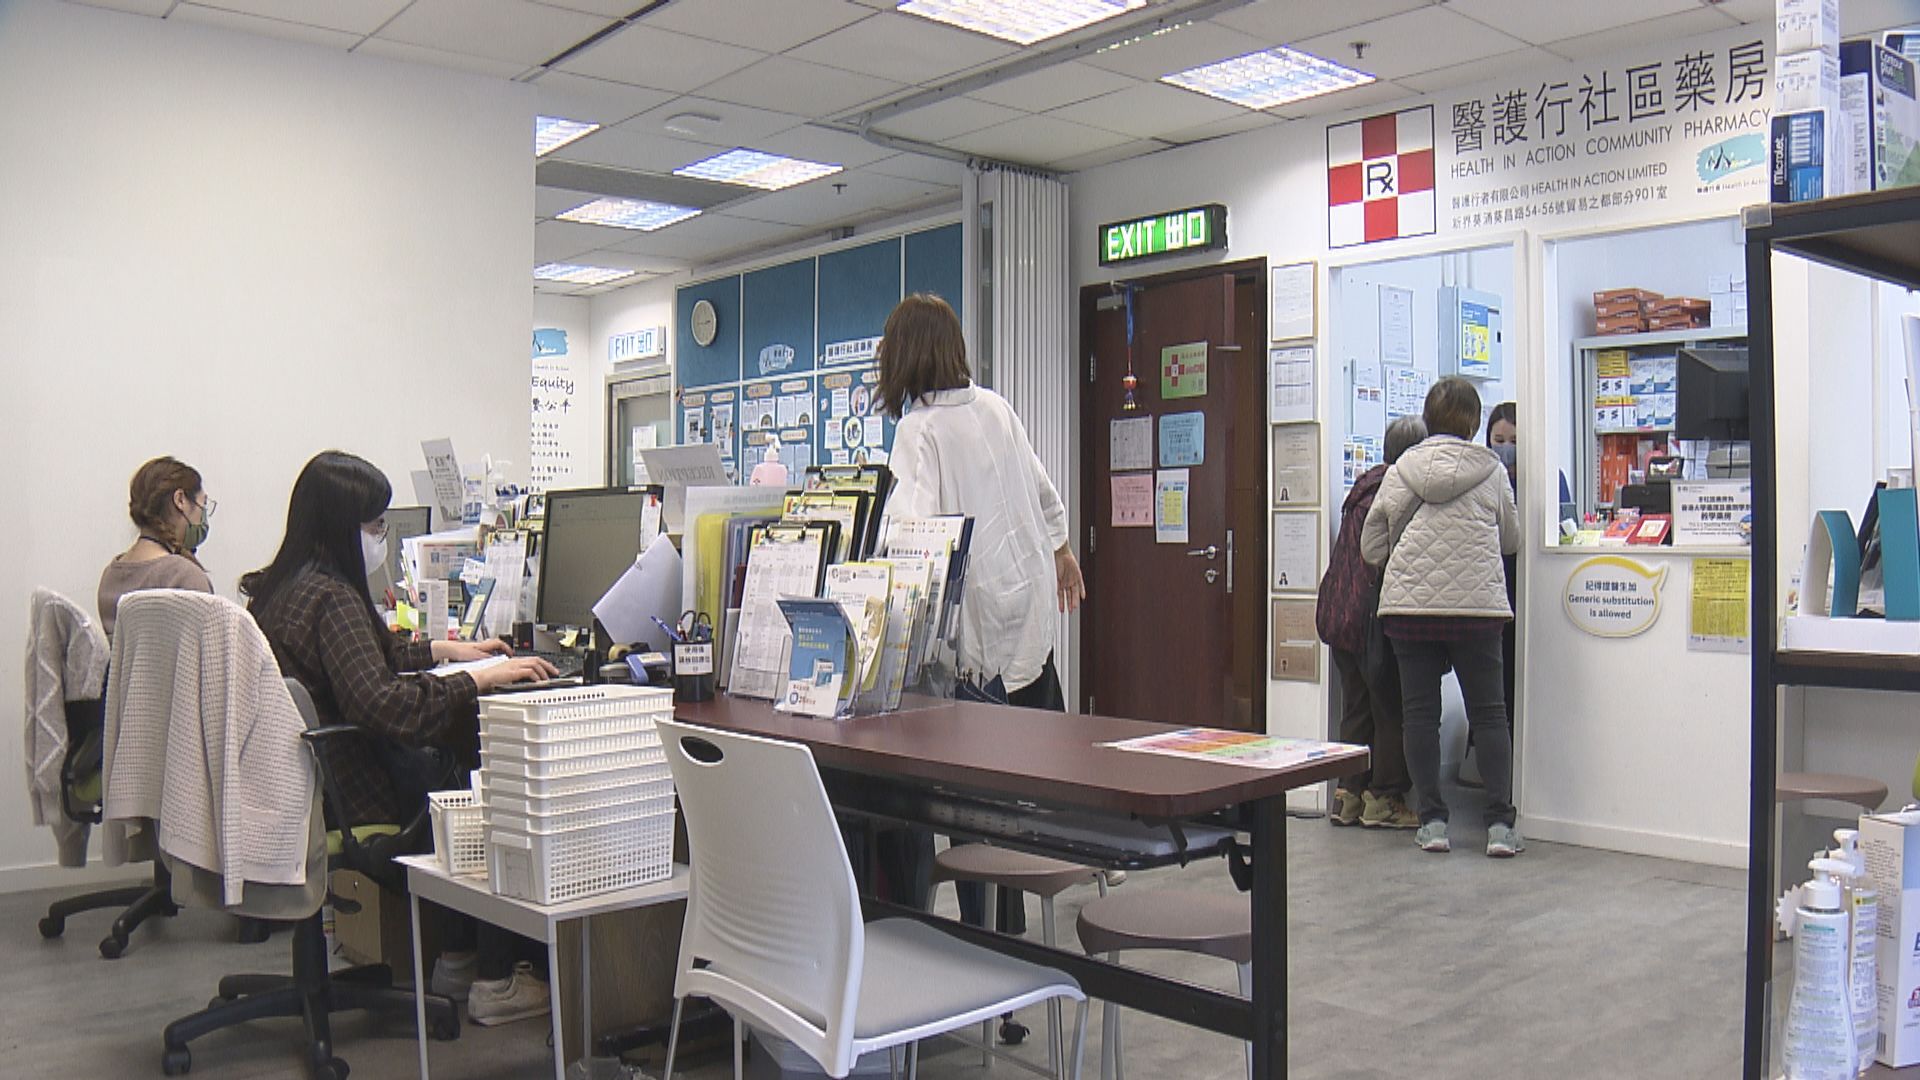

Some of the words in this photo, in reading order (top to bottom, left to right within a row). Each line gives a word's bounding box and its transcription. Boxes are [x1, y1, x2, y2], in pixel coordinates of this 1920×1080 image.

[1451, 40, 1768, 155] 醫護行社區藥房
[1451, 157, 1494, 179] HEALTH
[1503, 153, 1516, 170] IN
[1525, 143, 1576, 166] ACTION
[1586, 125, 1673, 155] COMMUNITY
[1684, 108, 1770, 139] PHARMACY
[1531, 179, 1568, 195] HEALTH
[1571, 176, 1581, 189] IN
[1584, 169, 1625, 187] ACTION
[1628, 162, 1668, 181] LIMITED
[1107, 219, 1156, 261] EXIT
[1165, 210, 1205, 251] 出口
[615, 335, 635, 358] EXIT
[639, 332, 652, 353] 出口
[532, 375, 574, 395] Equity
[1568, 594, 1600, 604] Generic
[1602, 596, 1655, 606] substitution
[1598, 608, 1632, 619] allowed
